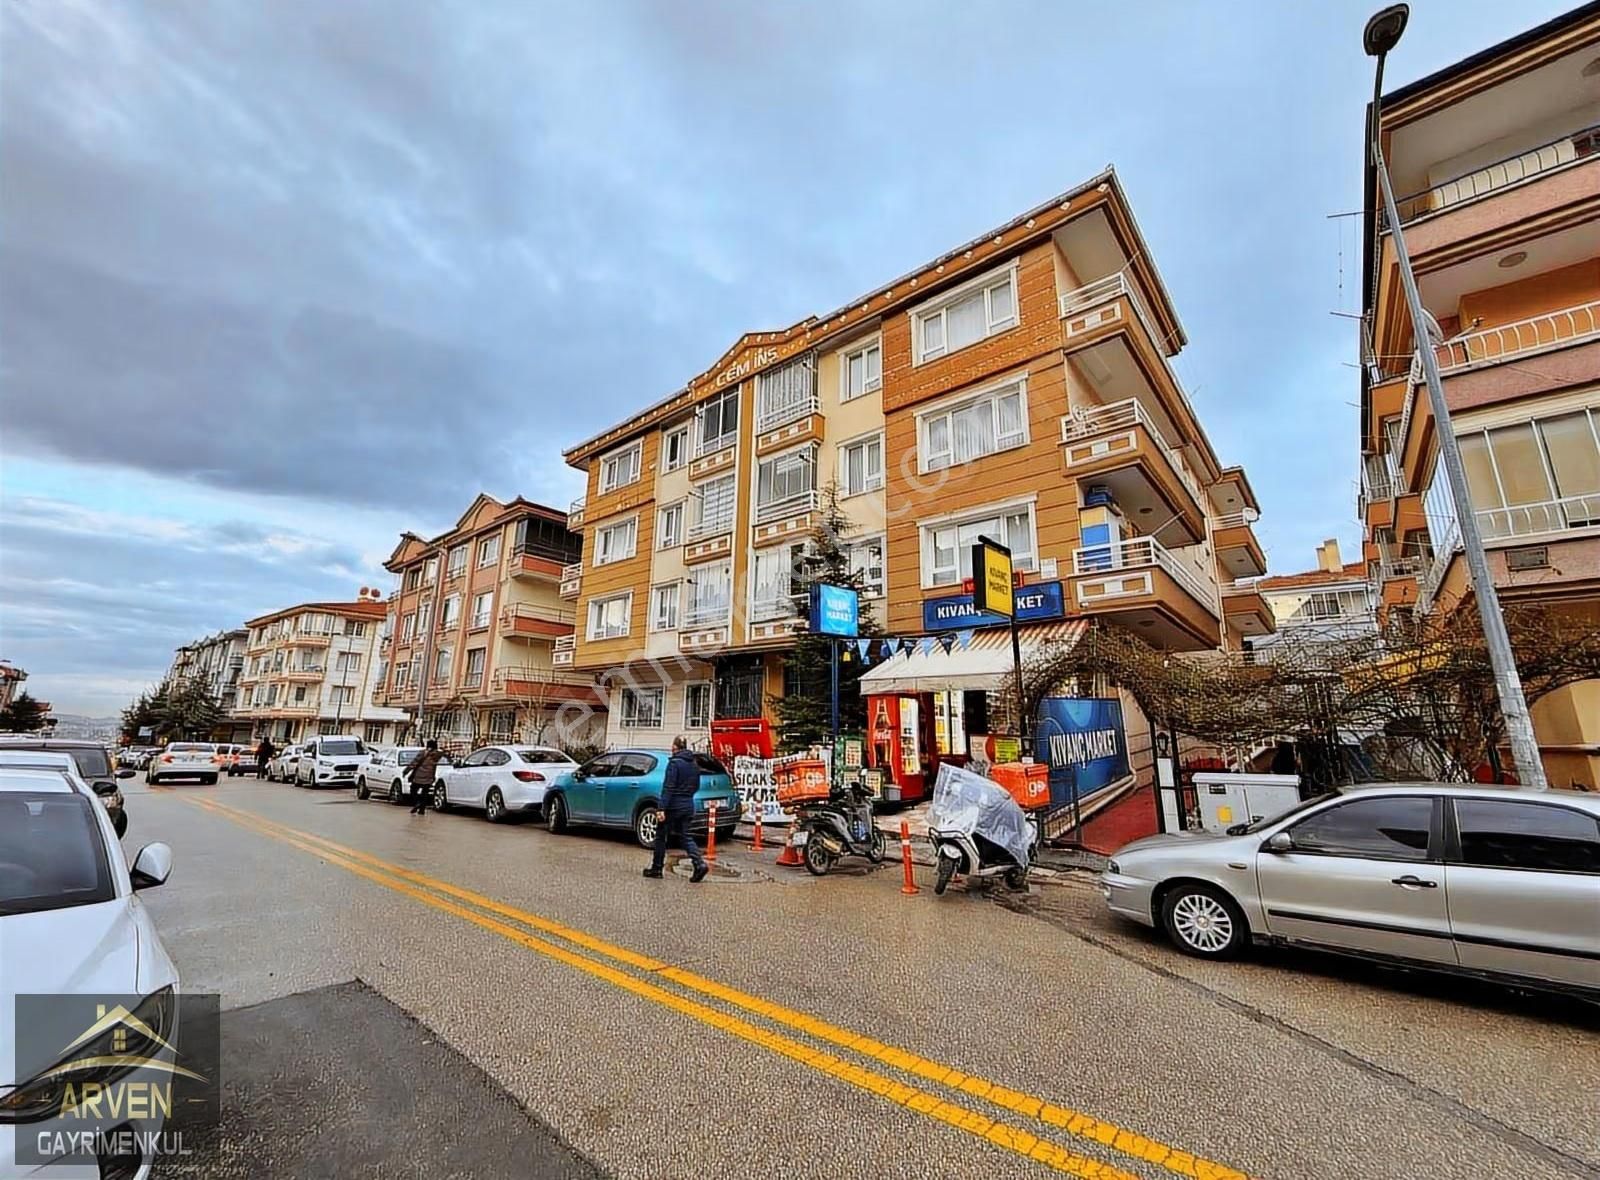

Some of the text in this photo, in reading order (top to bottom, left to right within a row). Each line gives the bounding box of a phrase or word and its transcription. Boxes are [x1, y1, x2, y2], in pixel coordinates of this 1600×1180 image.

[716, 360, 750, 387] CEM
[937, 594, 1044, 619] KIVAN KET
[1050, 732, 1085, 769] KIVANÇ
[1085, 730, 1117, 760] MARKET
